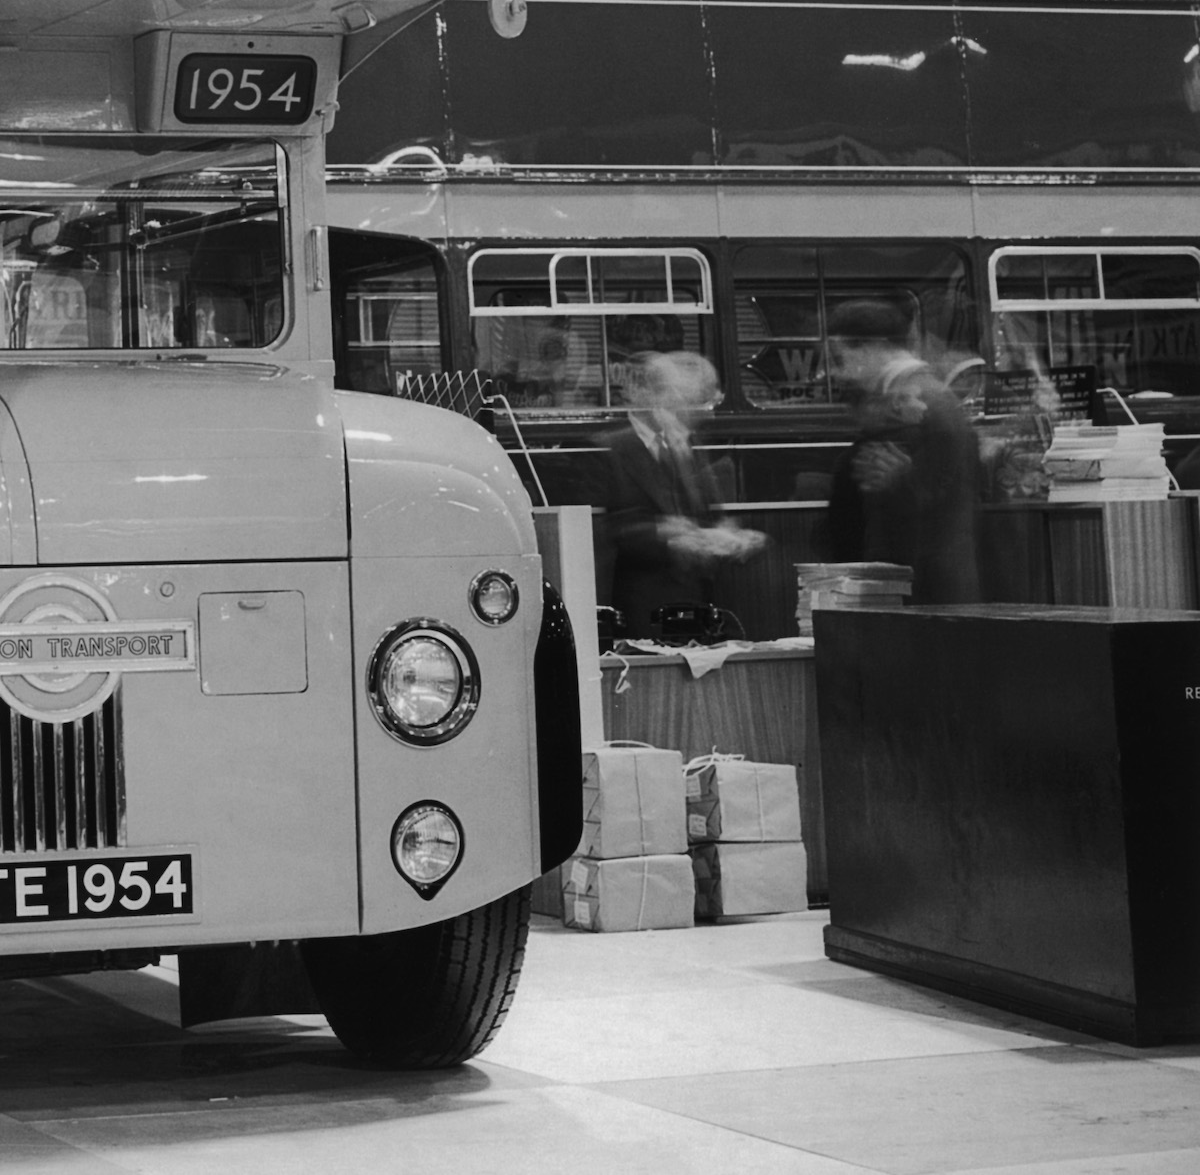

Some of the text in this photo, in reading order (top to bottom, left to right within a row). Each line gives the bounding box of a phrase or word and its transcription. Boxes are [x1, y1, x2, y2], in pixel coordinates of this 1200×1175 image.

[189, 68, 302, 113] 1954
[46, 635, 174, 658] TRANSPORT
[66, 859, 187, 915] 1954
